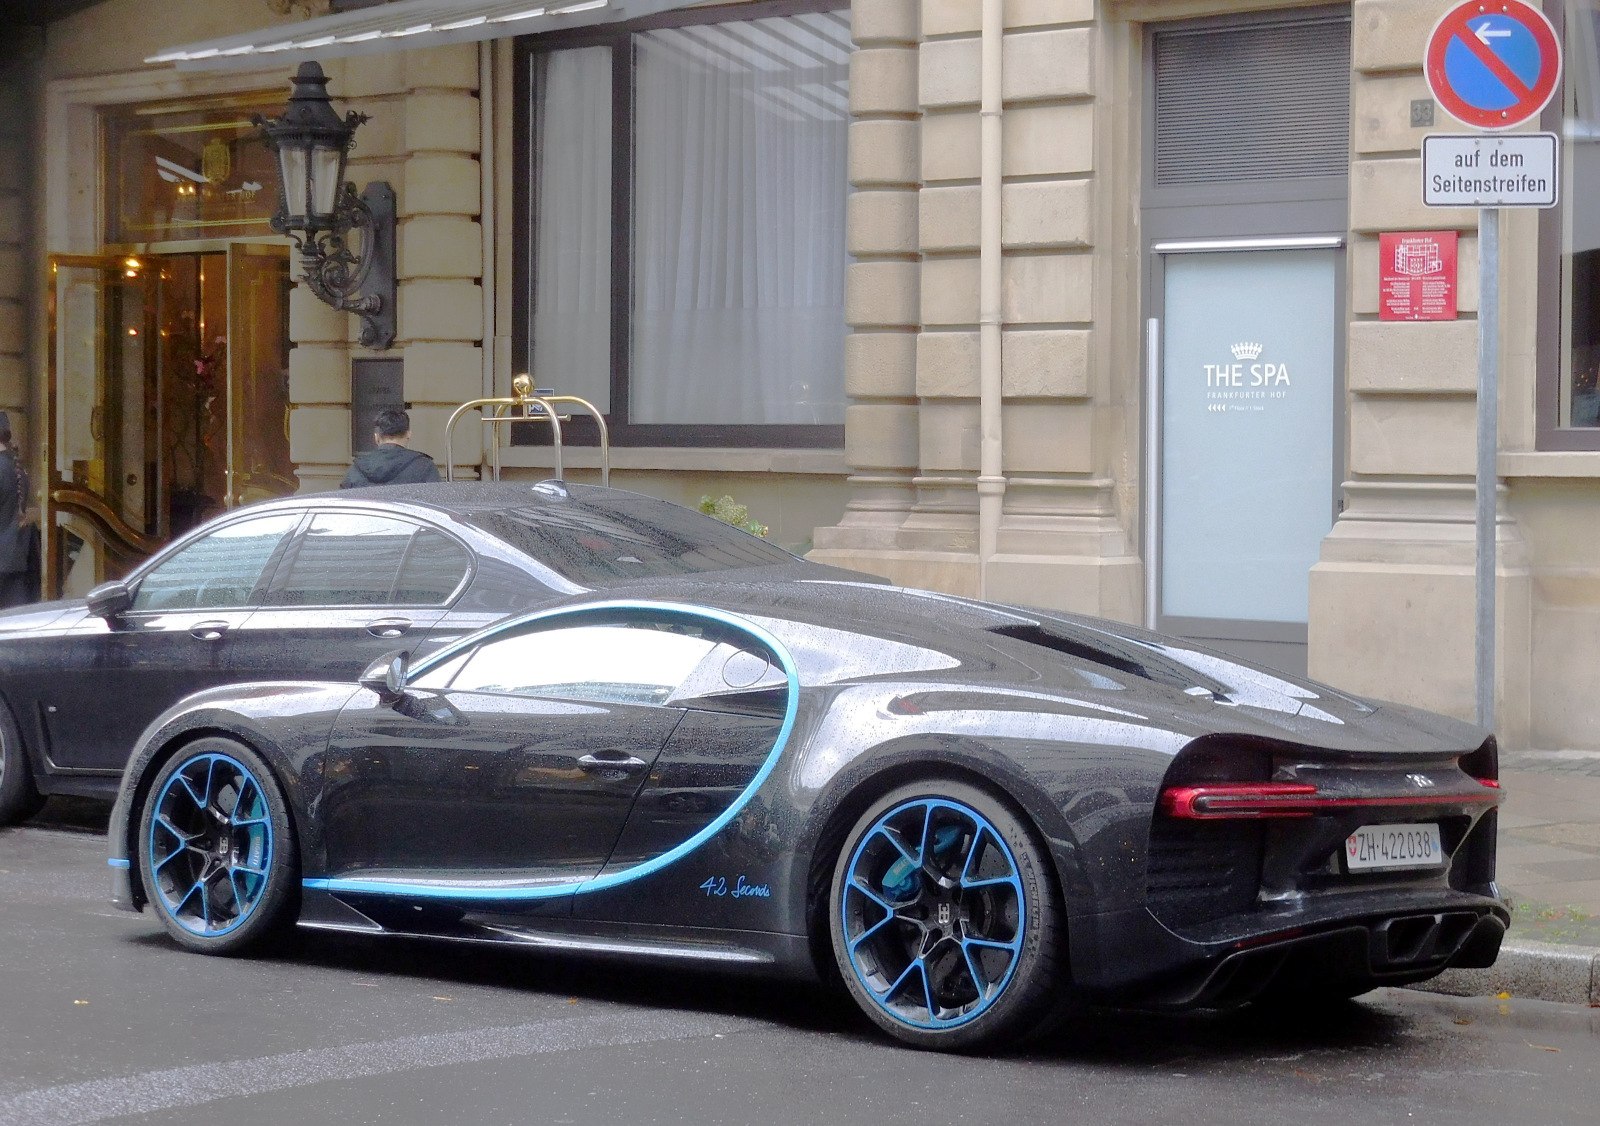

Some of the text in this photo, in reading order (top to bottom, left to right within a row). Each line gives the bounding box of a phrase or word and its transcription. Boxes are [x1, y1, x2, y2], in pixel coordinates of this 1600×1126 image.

[1454, 149, 1524, 167] auf dem
[1432, 174, 1546, 193] Seitenstreifen
[1203, 363, 1290, 387] THE SPA
[1207, 391, 1286, 399] FRANKFURTER HOF
[700, 875, 770, 898] 42 Seconds
